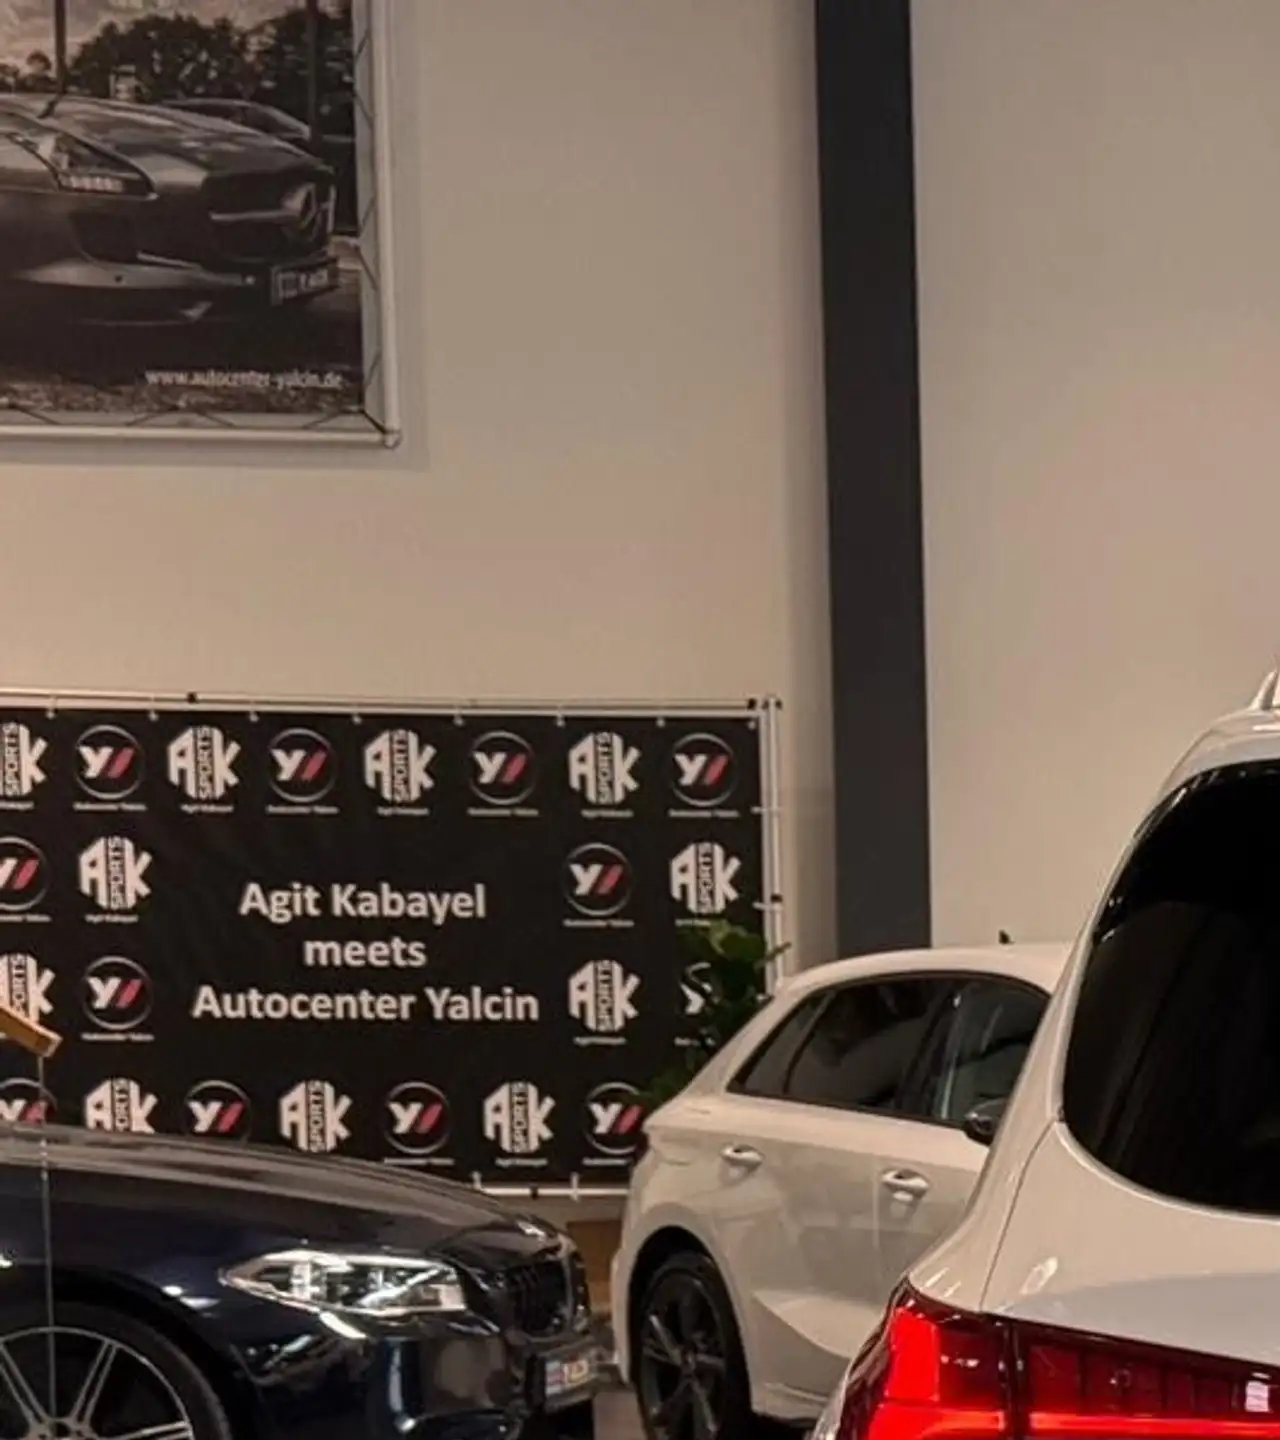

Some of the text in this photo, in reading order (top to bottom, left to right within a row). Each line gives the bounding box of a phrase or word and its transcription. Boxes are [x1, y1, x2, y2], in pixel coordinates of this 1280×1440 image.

[239, 882, 485, 925] Agit Kabayel
[304, 937, 426, 967] meets
[192, 985, 539, 1020] Autocenter Yalcin
